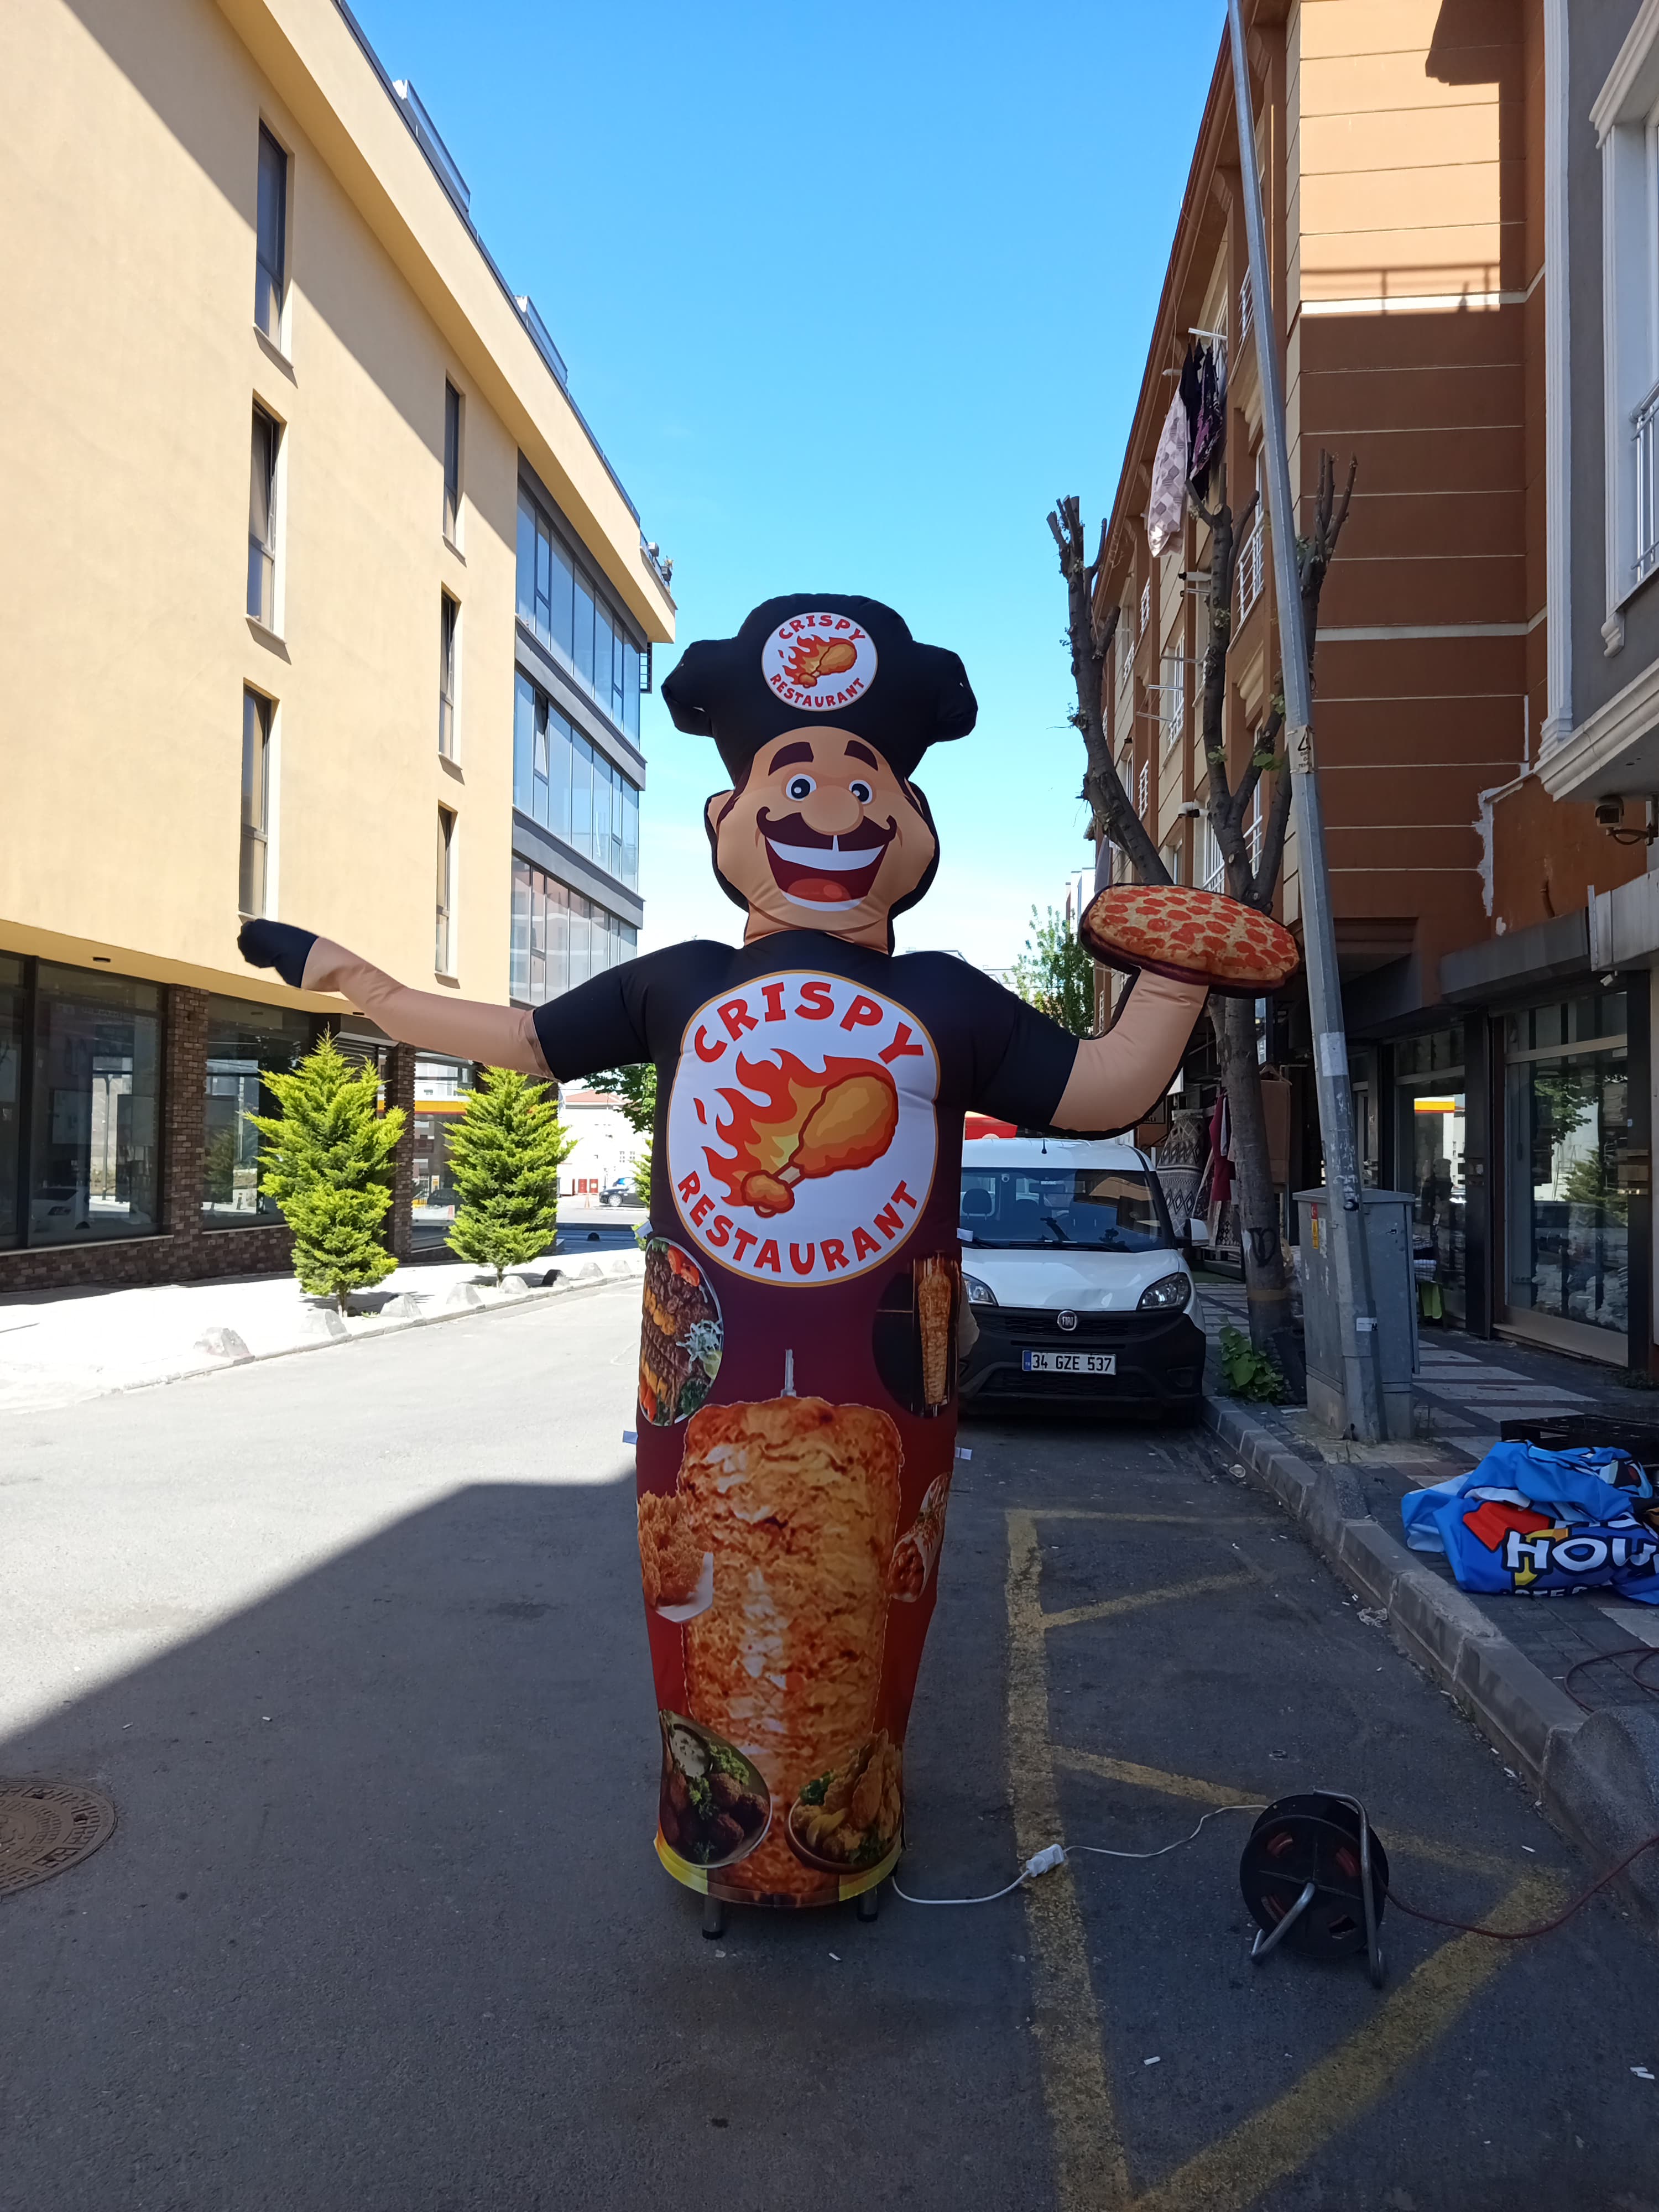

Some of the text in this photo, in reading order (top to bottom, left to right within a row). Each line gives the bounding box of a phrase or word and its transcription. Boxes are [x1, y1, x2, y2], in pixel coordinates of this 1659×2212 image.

[779, 615, 865, 641] CRISPY
[770, 674, 865, 707] RESTAURANT
[694, 982, 924, 1064] CRISPY
[677, 1171, 917, 1275] RESTAURANT
[1062, 1316, 1074, 1326] FIAT
[1032, 1354, 1112, 1371] 34 GZE 537
